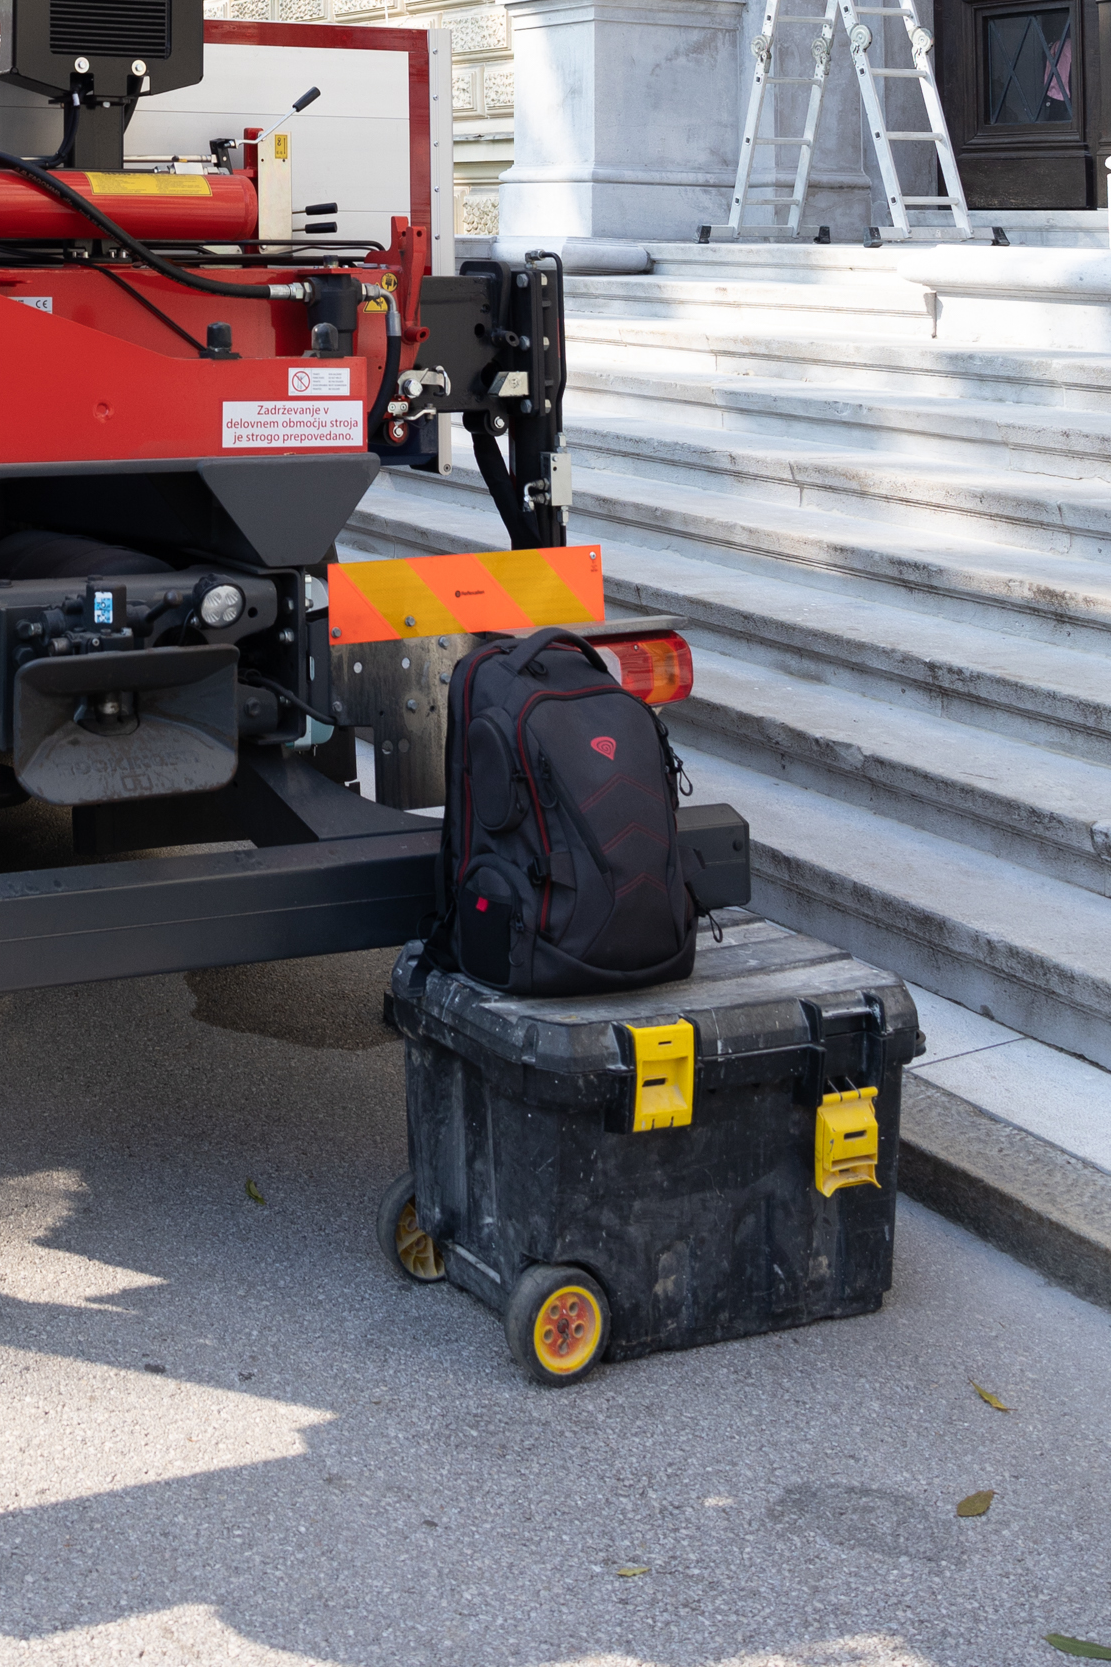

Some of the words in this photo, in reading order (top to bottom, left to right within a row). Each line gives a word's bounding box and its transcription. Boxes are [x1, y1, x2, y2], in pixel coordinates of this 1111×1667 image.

[256, 404, 321, 418] Zadrževanje
[323, 407, 330, 415] v
[226, 418, 279, 429] delovnem
[281, 417, 327, 431] območju
[329, 417, 359, 431] stroja
[232, 431, 243, 445] je
[245, 431, 280, 444] strogo
[282, 430, 354, 444] prepovedano.
